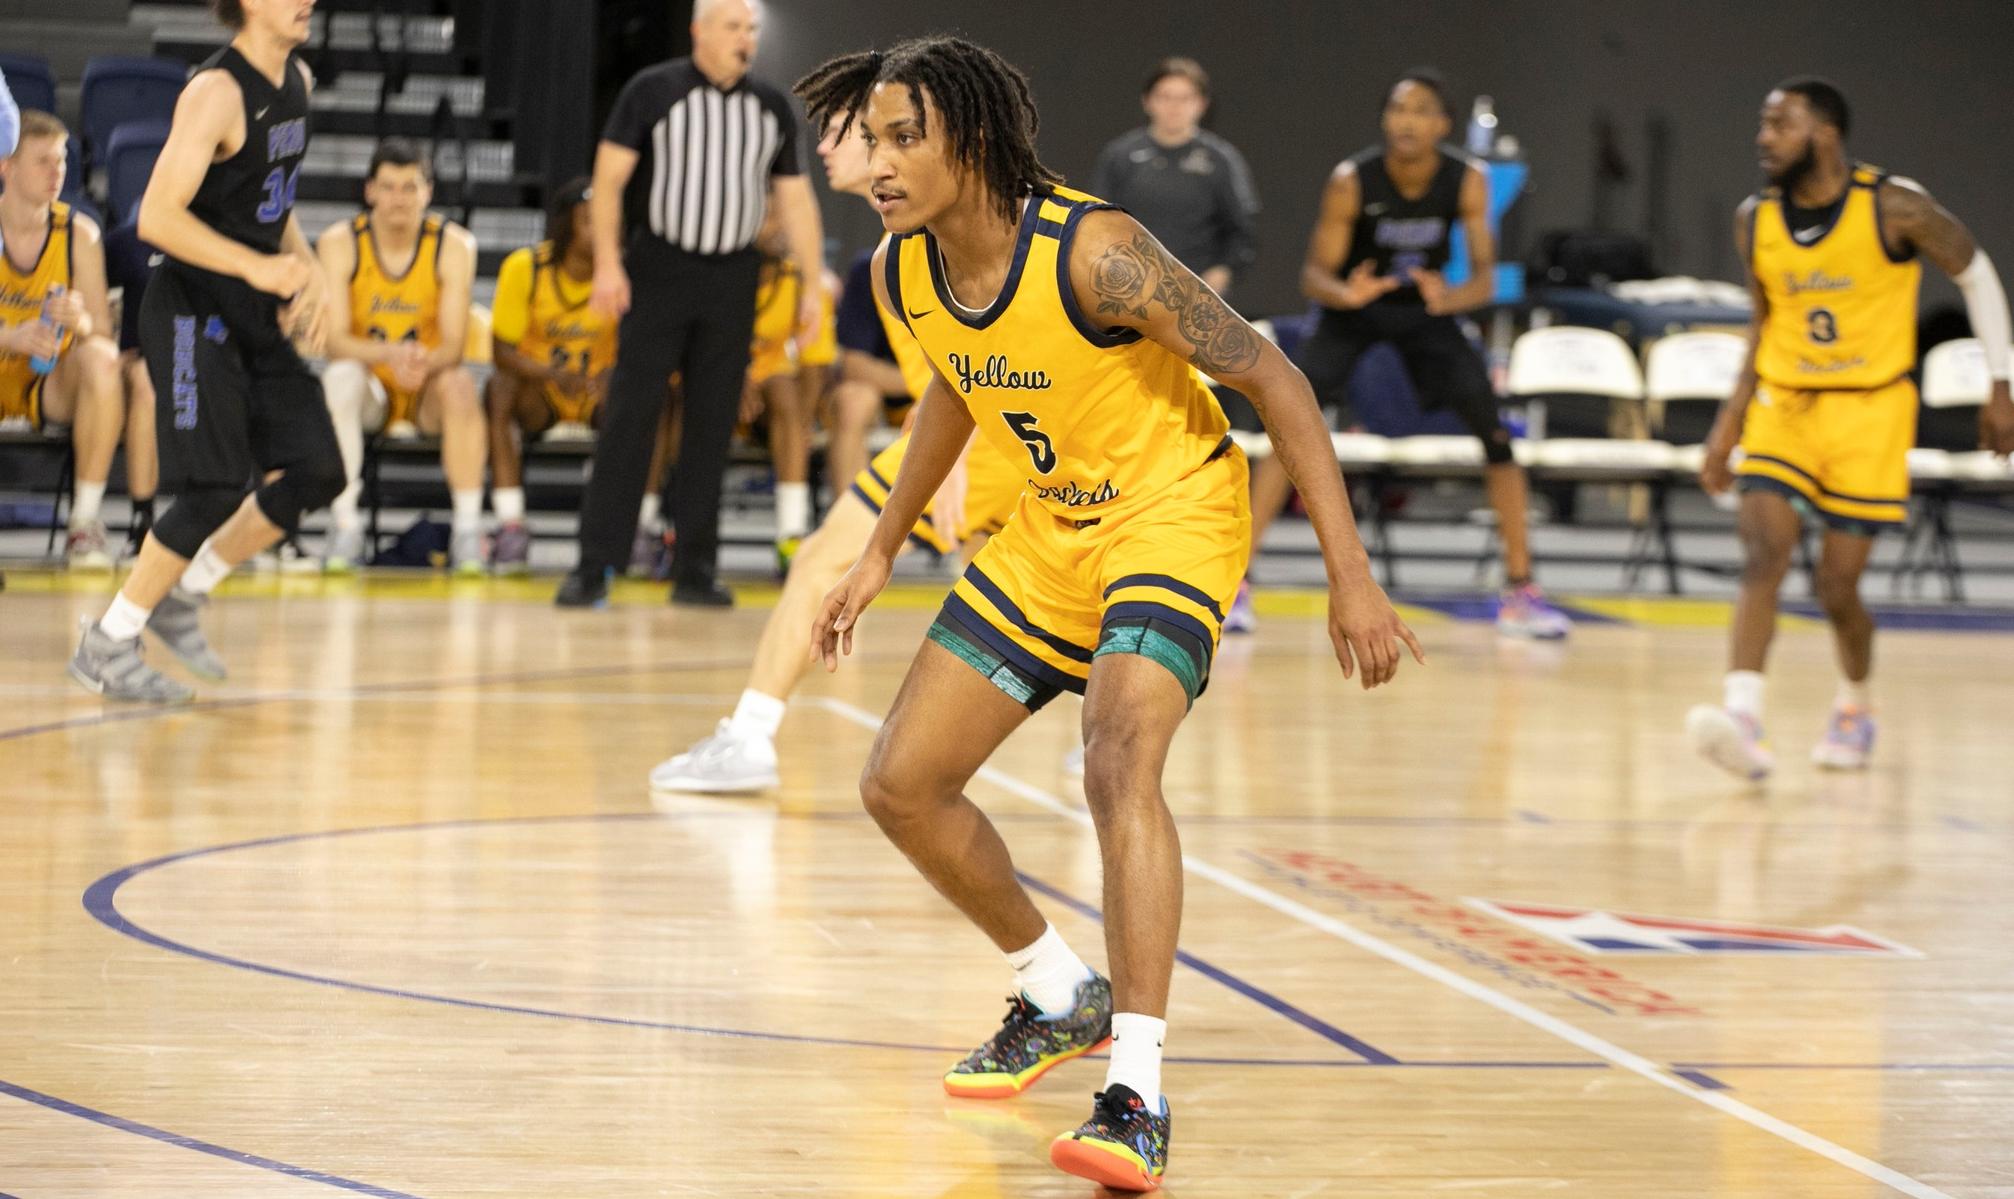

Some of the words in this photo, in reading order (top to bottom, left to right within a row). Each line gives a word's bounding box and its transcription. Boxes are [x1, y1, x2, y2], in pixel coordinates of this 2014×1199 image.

[1806, 306, 1837, 345] 3
[948, 352, 1052, 394] Yellow
[1000, 410, 1057, 475] 5
